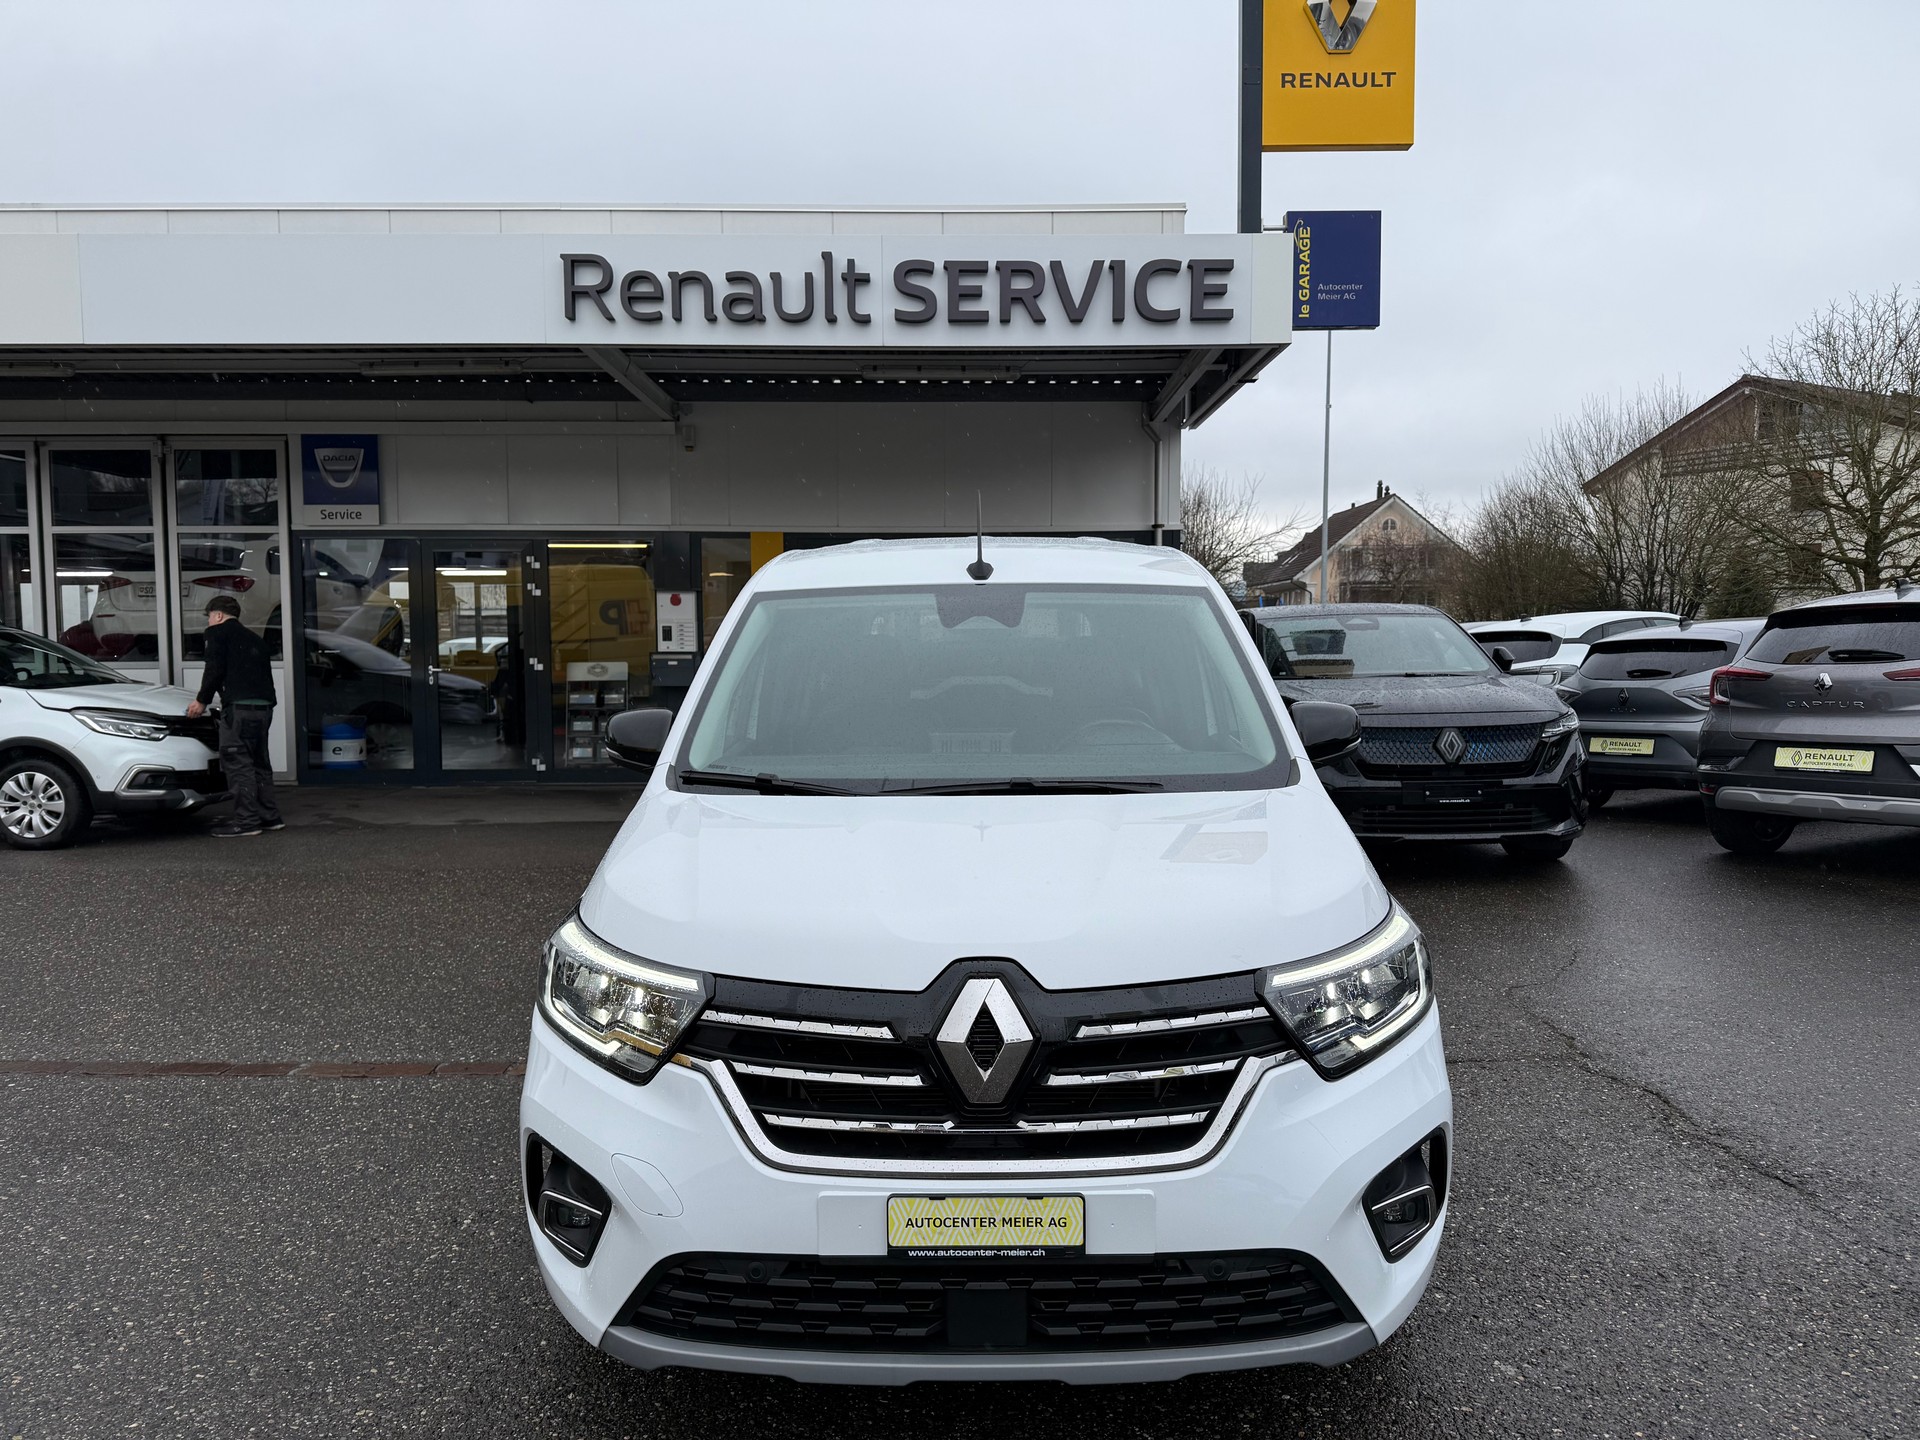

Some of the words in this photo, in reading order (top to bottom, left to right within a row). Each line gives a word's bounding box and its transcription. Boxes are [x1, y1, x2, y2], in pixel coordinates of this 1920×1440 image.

[1280, 71, 1397, 89] RENAULT
[1298, 226, 1311, 301] GARAGE
[559, 251, 871, 324] Renault
[893, 258, 1235, 324] SERVICE
[1317, 282, 1364, 291] Autocenter
[1317, 292, 1341, 301] Meier
[1342, 292, 1356, 301] AG
[1298, 304, 1310, 319] le
[320, 509, 362, 519] Service
[1786, 700, 1865, 709] CAPTUR
[1804, 752, 1855, 762] RENAULT
[904, 1216, 998, 1228] AUTOCENTER
[1001, 1216, 1044, 1228] MEIER
[1047, 1216, 1068, 1228] AG
[908, 1248, 1046, 1257] www.autocenter-meier.ch
